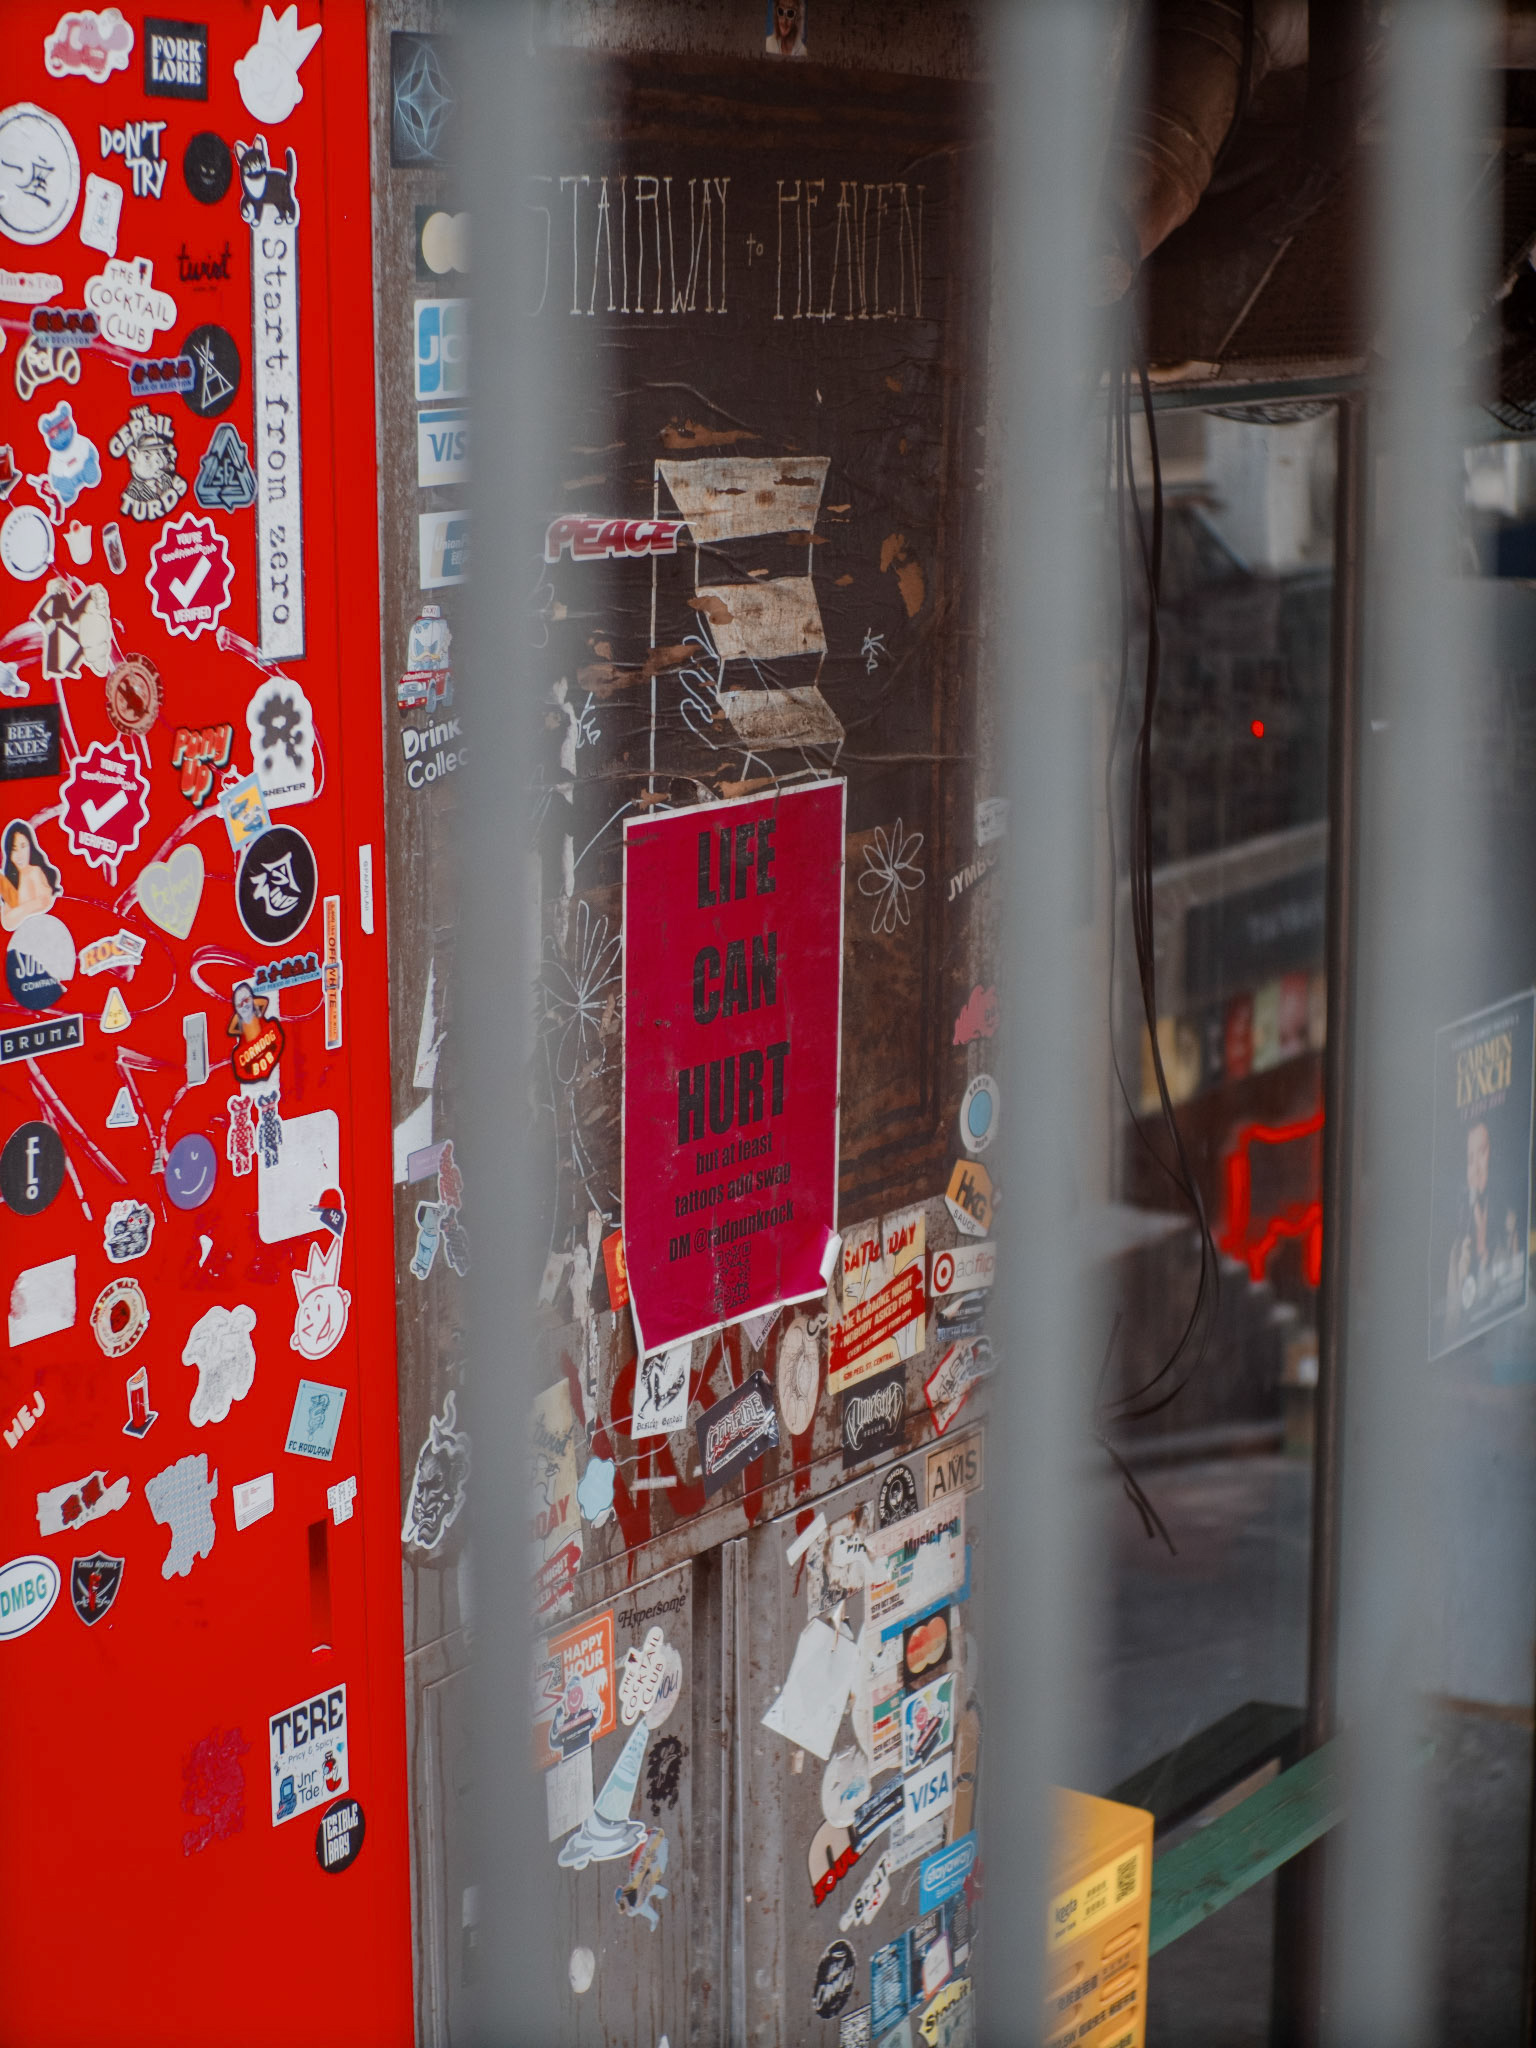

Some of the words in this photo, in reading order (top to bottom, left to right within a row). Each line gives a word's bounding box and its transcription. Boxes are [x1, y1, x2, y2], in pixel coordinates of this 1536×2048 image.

[151, 34, 201, 62] FORK
[152, 59, 201, 85] LORE
[100, 121, 166, 159] DON'T
[125, 157, 167, 199] TRY
[747, 233, 763, 265] to
[773, 179, 926, 322] HEAVEN
[111, 267, 133, 285] THE
[90, 282, 169, 323] COCKTAIL
[107, 313, 145, 345] CLUB
[130, 404, 150, 418] THE
[109, 414, 176, 458] GERBIL
[265, 395, 290, 503] from
[428, 430, 468, 462] VIS
[120, 480, 188, 521] TURDS
[550, 519, 682, 559] PEACE
[269, 526, 290, 624] zero
[173, 606, 211, 623] VERIFIED
[4, 739, 48, 756] KNEES
[402, 718, 463, 760] Drink
[263, 782, 306, 797] SHELTER
[697, 818, 777, 909] LIFE
[21, 978, 60, 992] COMPAN
[693, 931, 777, 1024] CAN
[4, 1025, 78, 1053] BRUMA
[239, 1030, 277, 1067] CORNDOG
[251, 1051, 275, 1076] BOB
[678, 1041, 790, 1146] HURT
[696, 1149, 719, 1175] but
[722, 1144, 736, 1167] at
[738, 1131, 773, 1162] least
[675, 1184, 724, 1218] tattoos
[728, 1171, 753, 1201] add
[756, 1163, 791, 1190] swag
[669, 1232, 691, 1262] DM
[694, 1200, 794, 1253] @radpunkrock
[953, 1209, 977, 1233] SAUCE
[856, 1290, 890, 1323] KARAOKE
[891, 1274, 913, 1299] NIGHT
[844, 1318, 872, 1347] NOBODY
[875, 1300, 897, 1326] ASKED
[899, 1290, 913, 1309] FOR
[904, 1530, 935, 1561] Music
[0, 1574, 47, 1618] DMBG
[563, 1631, 604, 1664] HAPPY
[564, 1648, 604, 1682] HOUR
[623, 1670, 635, 1694] THE
[643, 1663, 664, 1704] CLUB
[272, 1689, 343, 1755] TERE
[288, 1750, 306, 1765] Pricy
[315, 1737, 334, 1753] Spicy
[297, 1770, 318, 1789] Jnr
[299, 1786, 320, 1804] Tde
[908, 1770, 949, 1814] VISA
[328, 1833, 350, 1864] BABY
